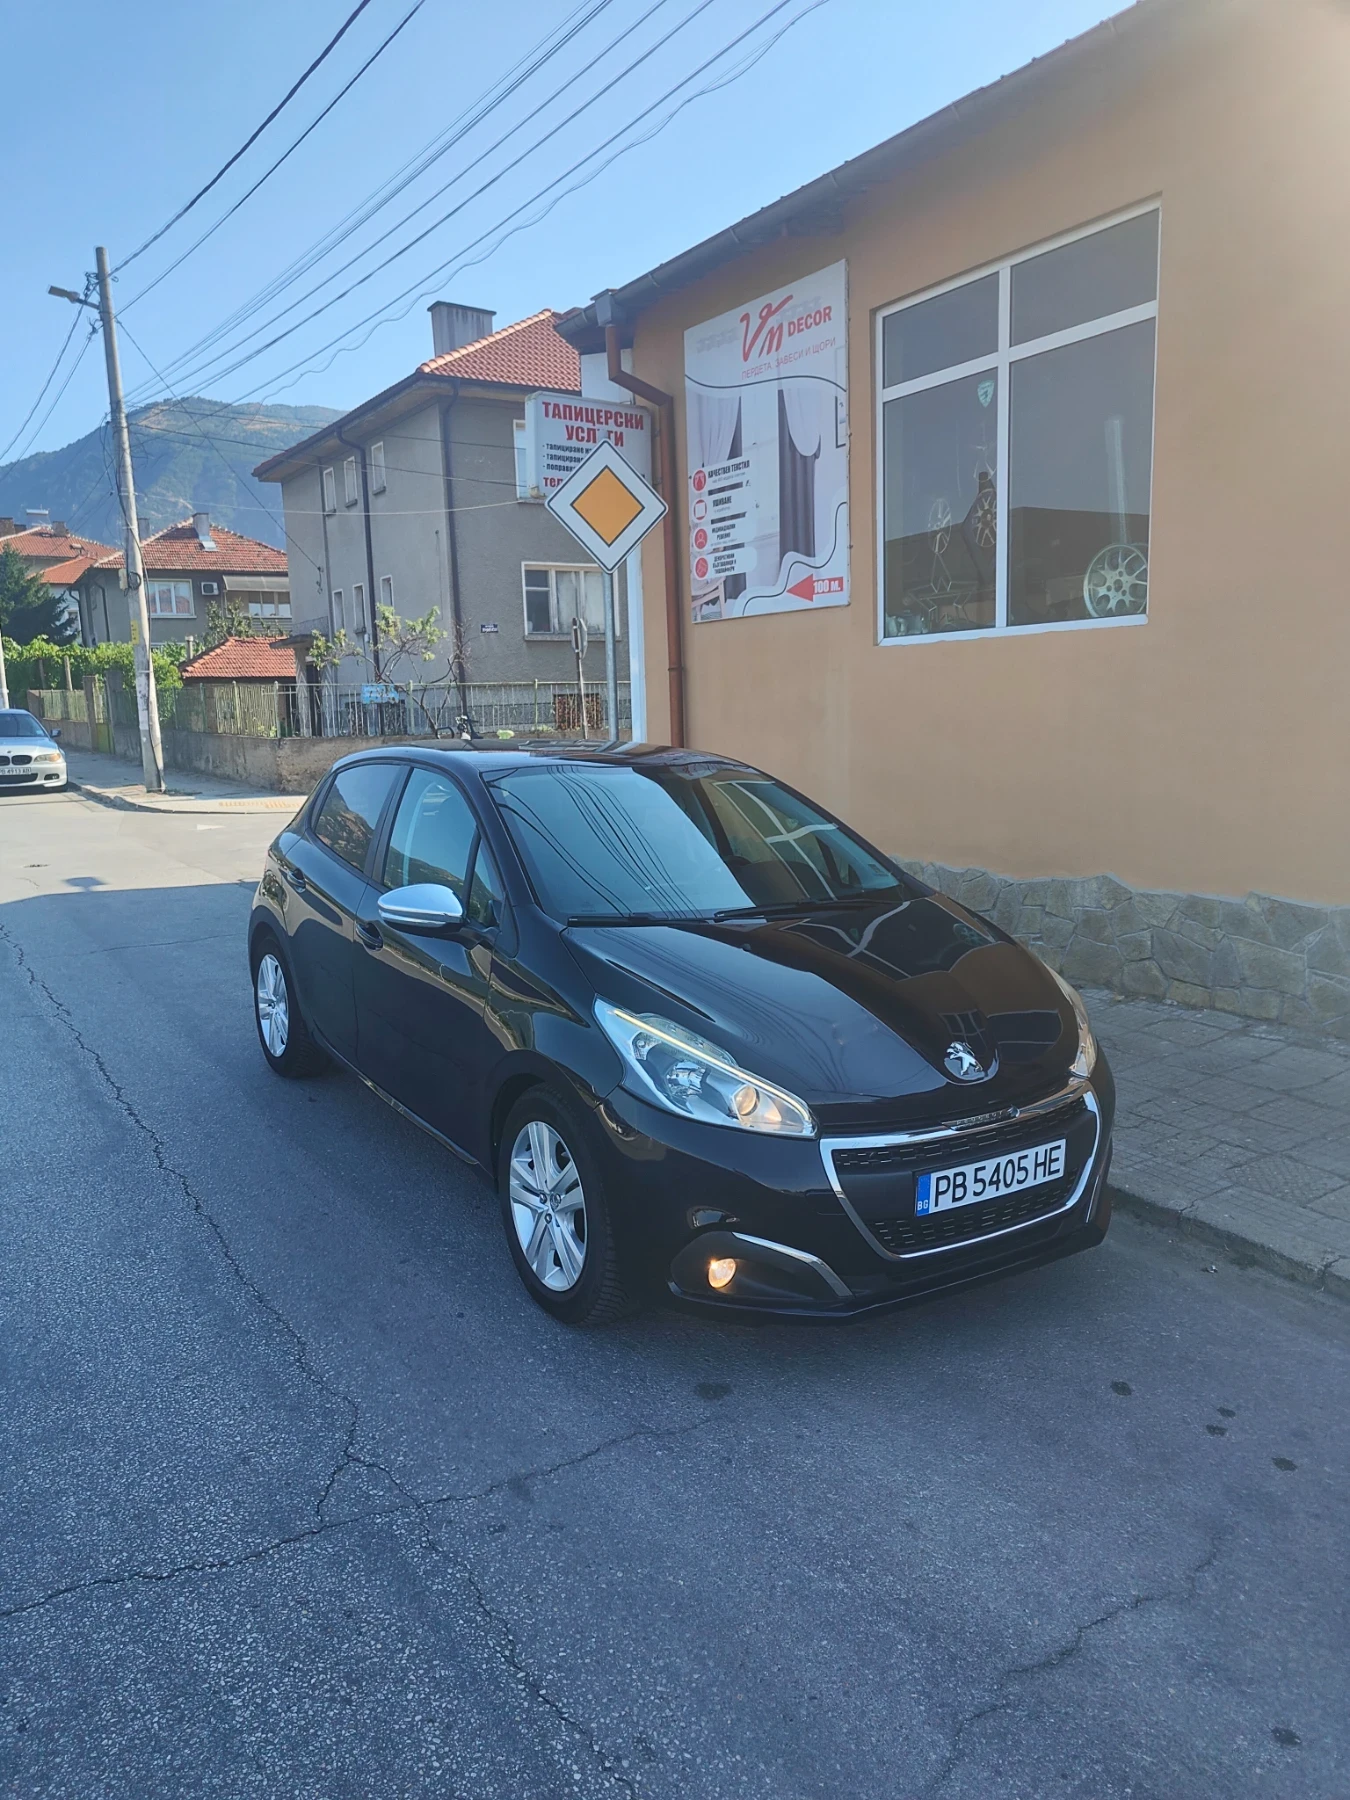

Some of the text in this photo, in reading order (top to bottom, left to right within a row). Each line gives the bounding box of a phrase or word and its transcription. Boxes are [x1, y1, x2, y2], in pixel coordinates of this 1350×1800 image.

[787, 305, 832, 337] DECOR
[775, 350, 804, 368] ЗАВЕСИ
[542, 401, 644, 430] ТАПИЦЕРСКИ
[565, 424, 624, 447] УСЛГИ
[813, 580, 829, 594] 100
[917, 1145, 1062, 1211] BG PB 5405 HE
